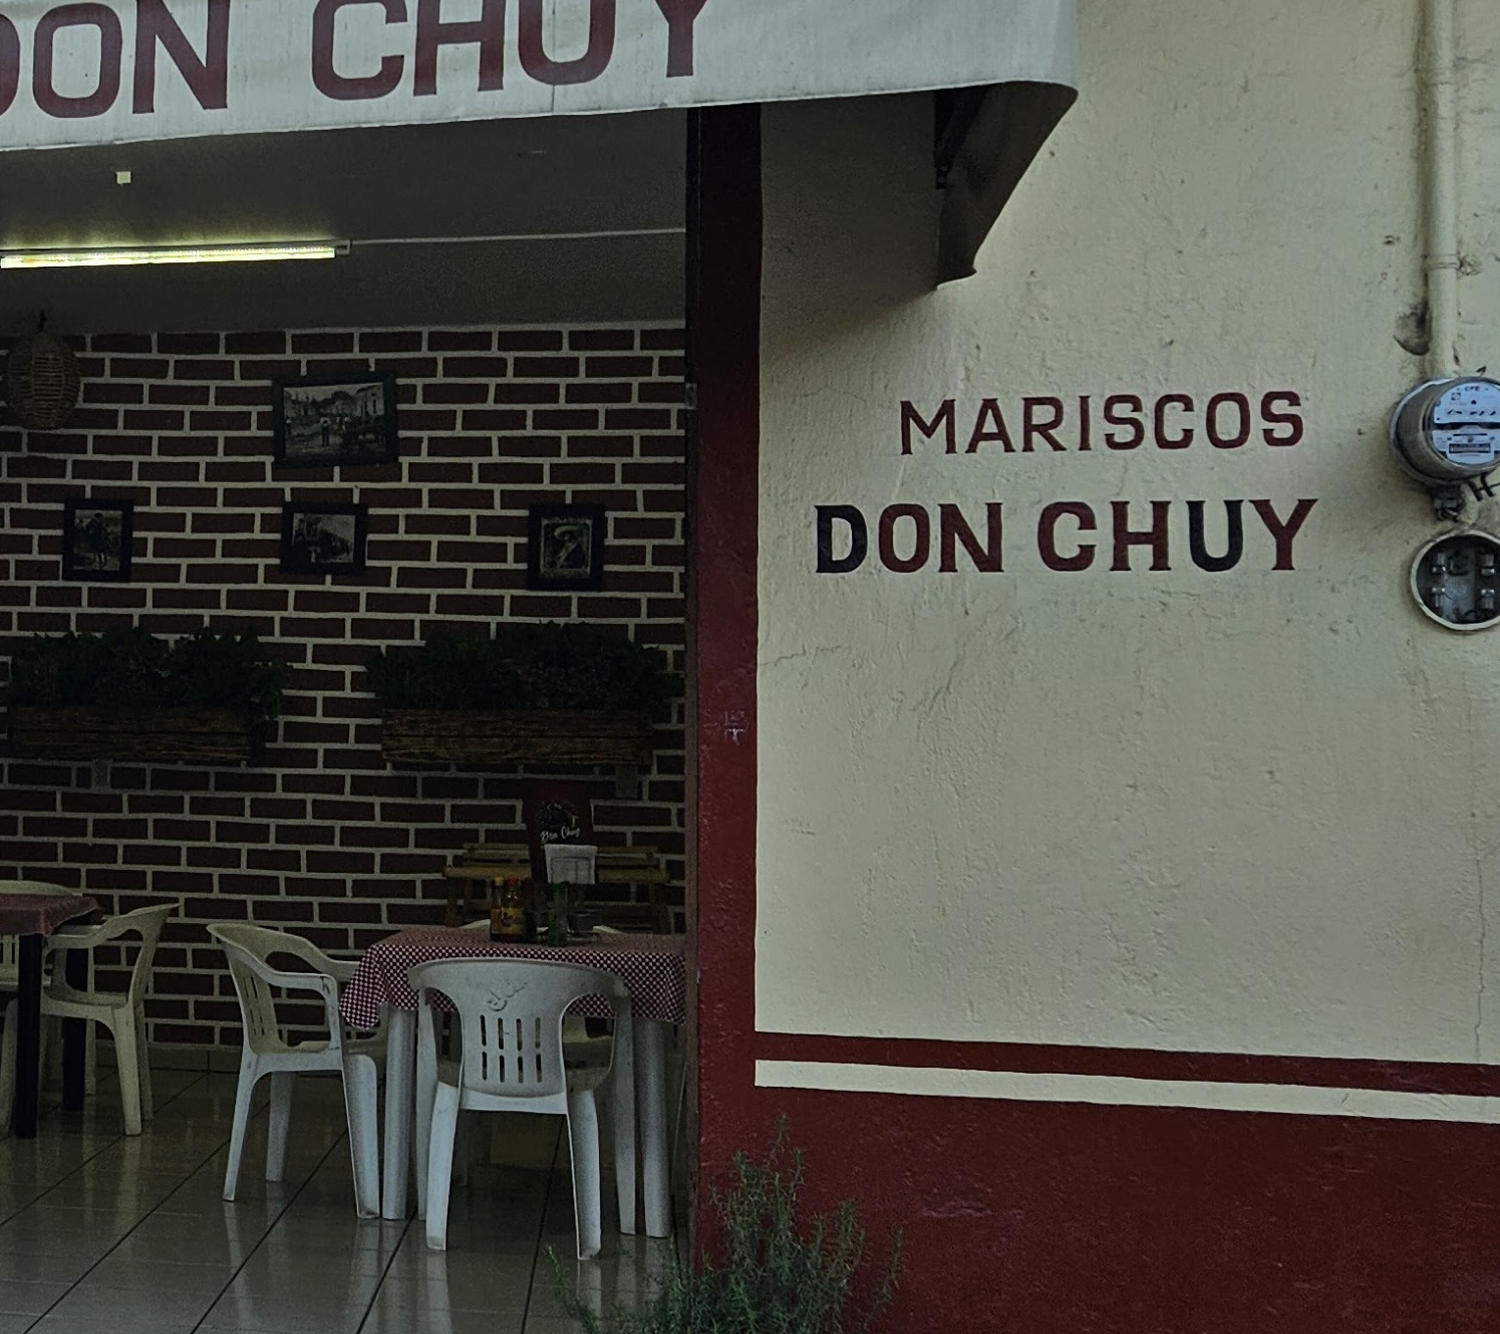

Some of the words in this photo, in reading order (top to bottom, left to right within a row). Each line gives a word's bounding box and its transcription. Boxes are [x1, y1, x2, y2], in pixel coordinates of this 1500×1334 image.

[900, 391, 1303, 455] MARISCOS
[814, 503, 1004, 573] DON
[1037, 499, 1319, 572] CHUY
